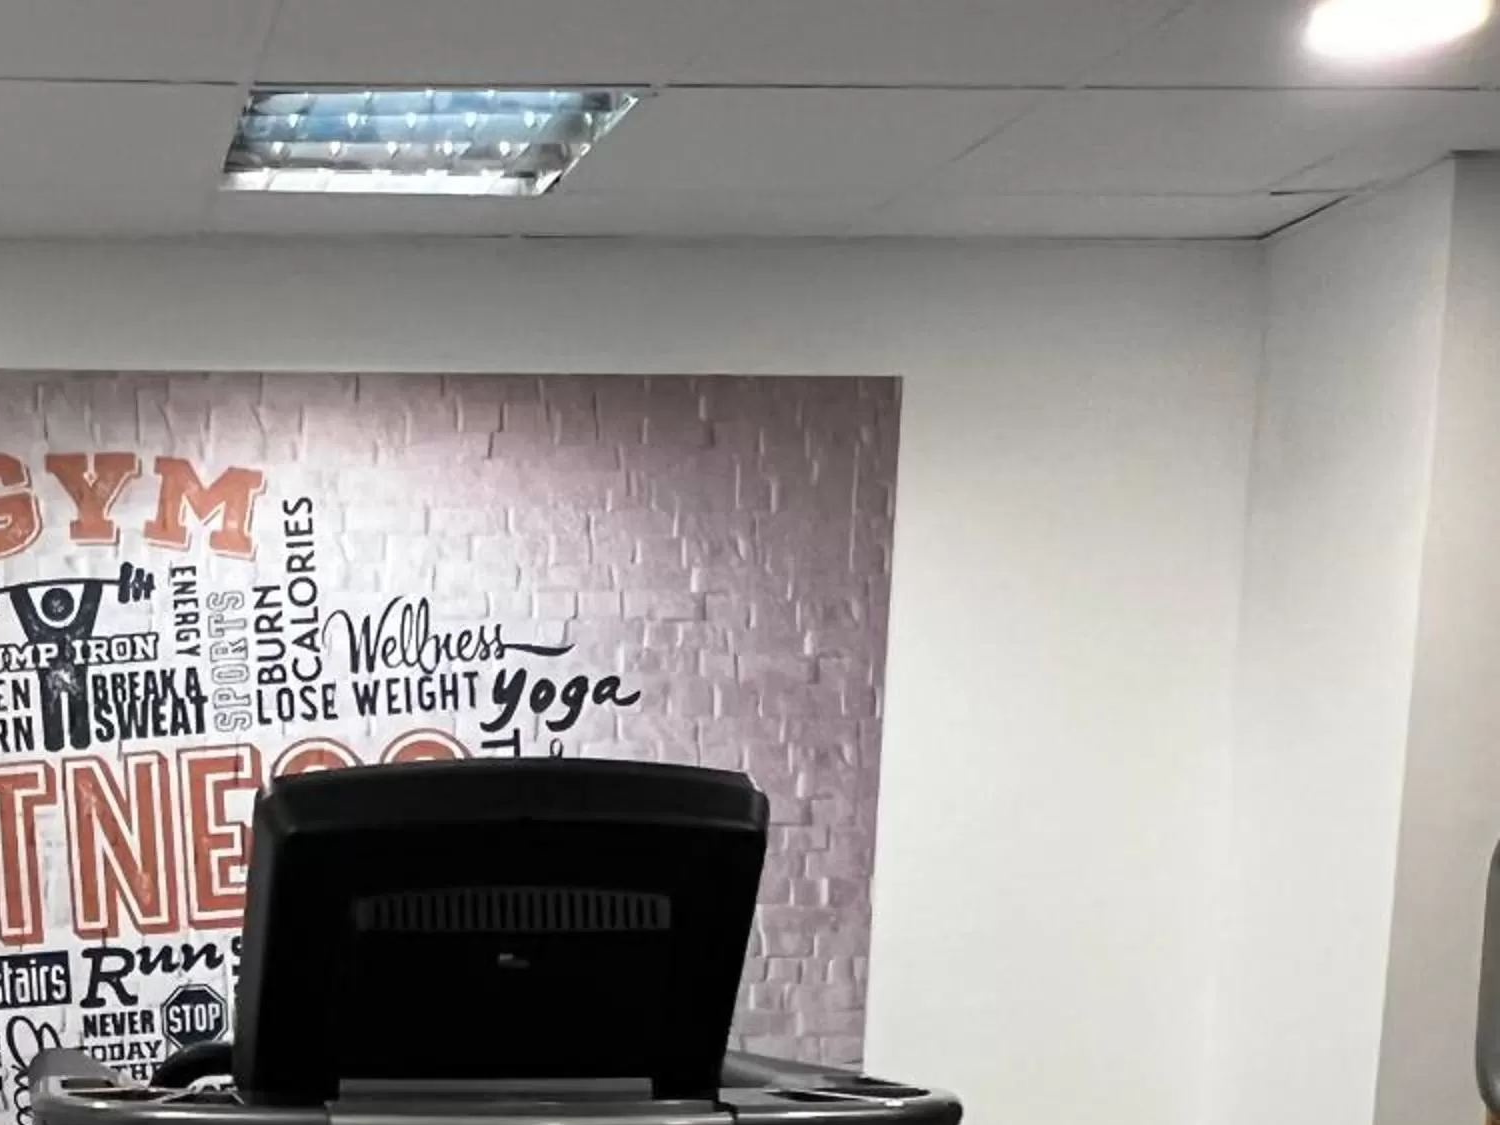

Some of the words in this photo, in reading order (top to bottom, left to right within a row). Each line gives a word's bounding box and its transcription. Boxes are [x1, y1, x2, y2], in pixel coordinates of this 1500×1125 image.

[171, 565, 201, 657] ENERGY
[282, 497, 323, 682] CALORIES
[69, 632, 160, 666] IRON
[206, 590, 252, 733] SPORTS
[252, 585, 287, 685] BURN
[322, 595, 575, 675] Wellness
[92, 668, 176, 704] BREAK
[256, 683, 339, 726] LOSE
[350, 671, 479, 718] WEIGHT
[94, 697, 208, 742] SWEAT
[83, 1009, 155, 1038] NEVER
[168, 1003, 221, 1033] STOP
